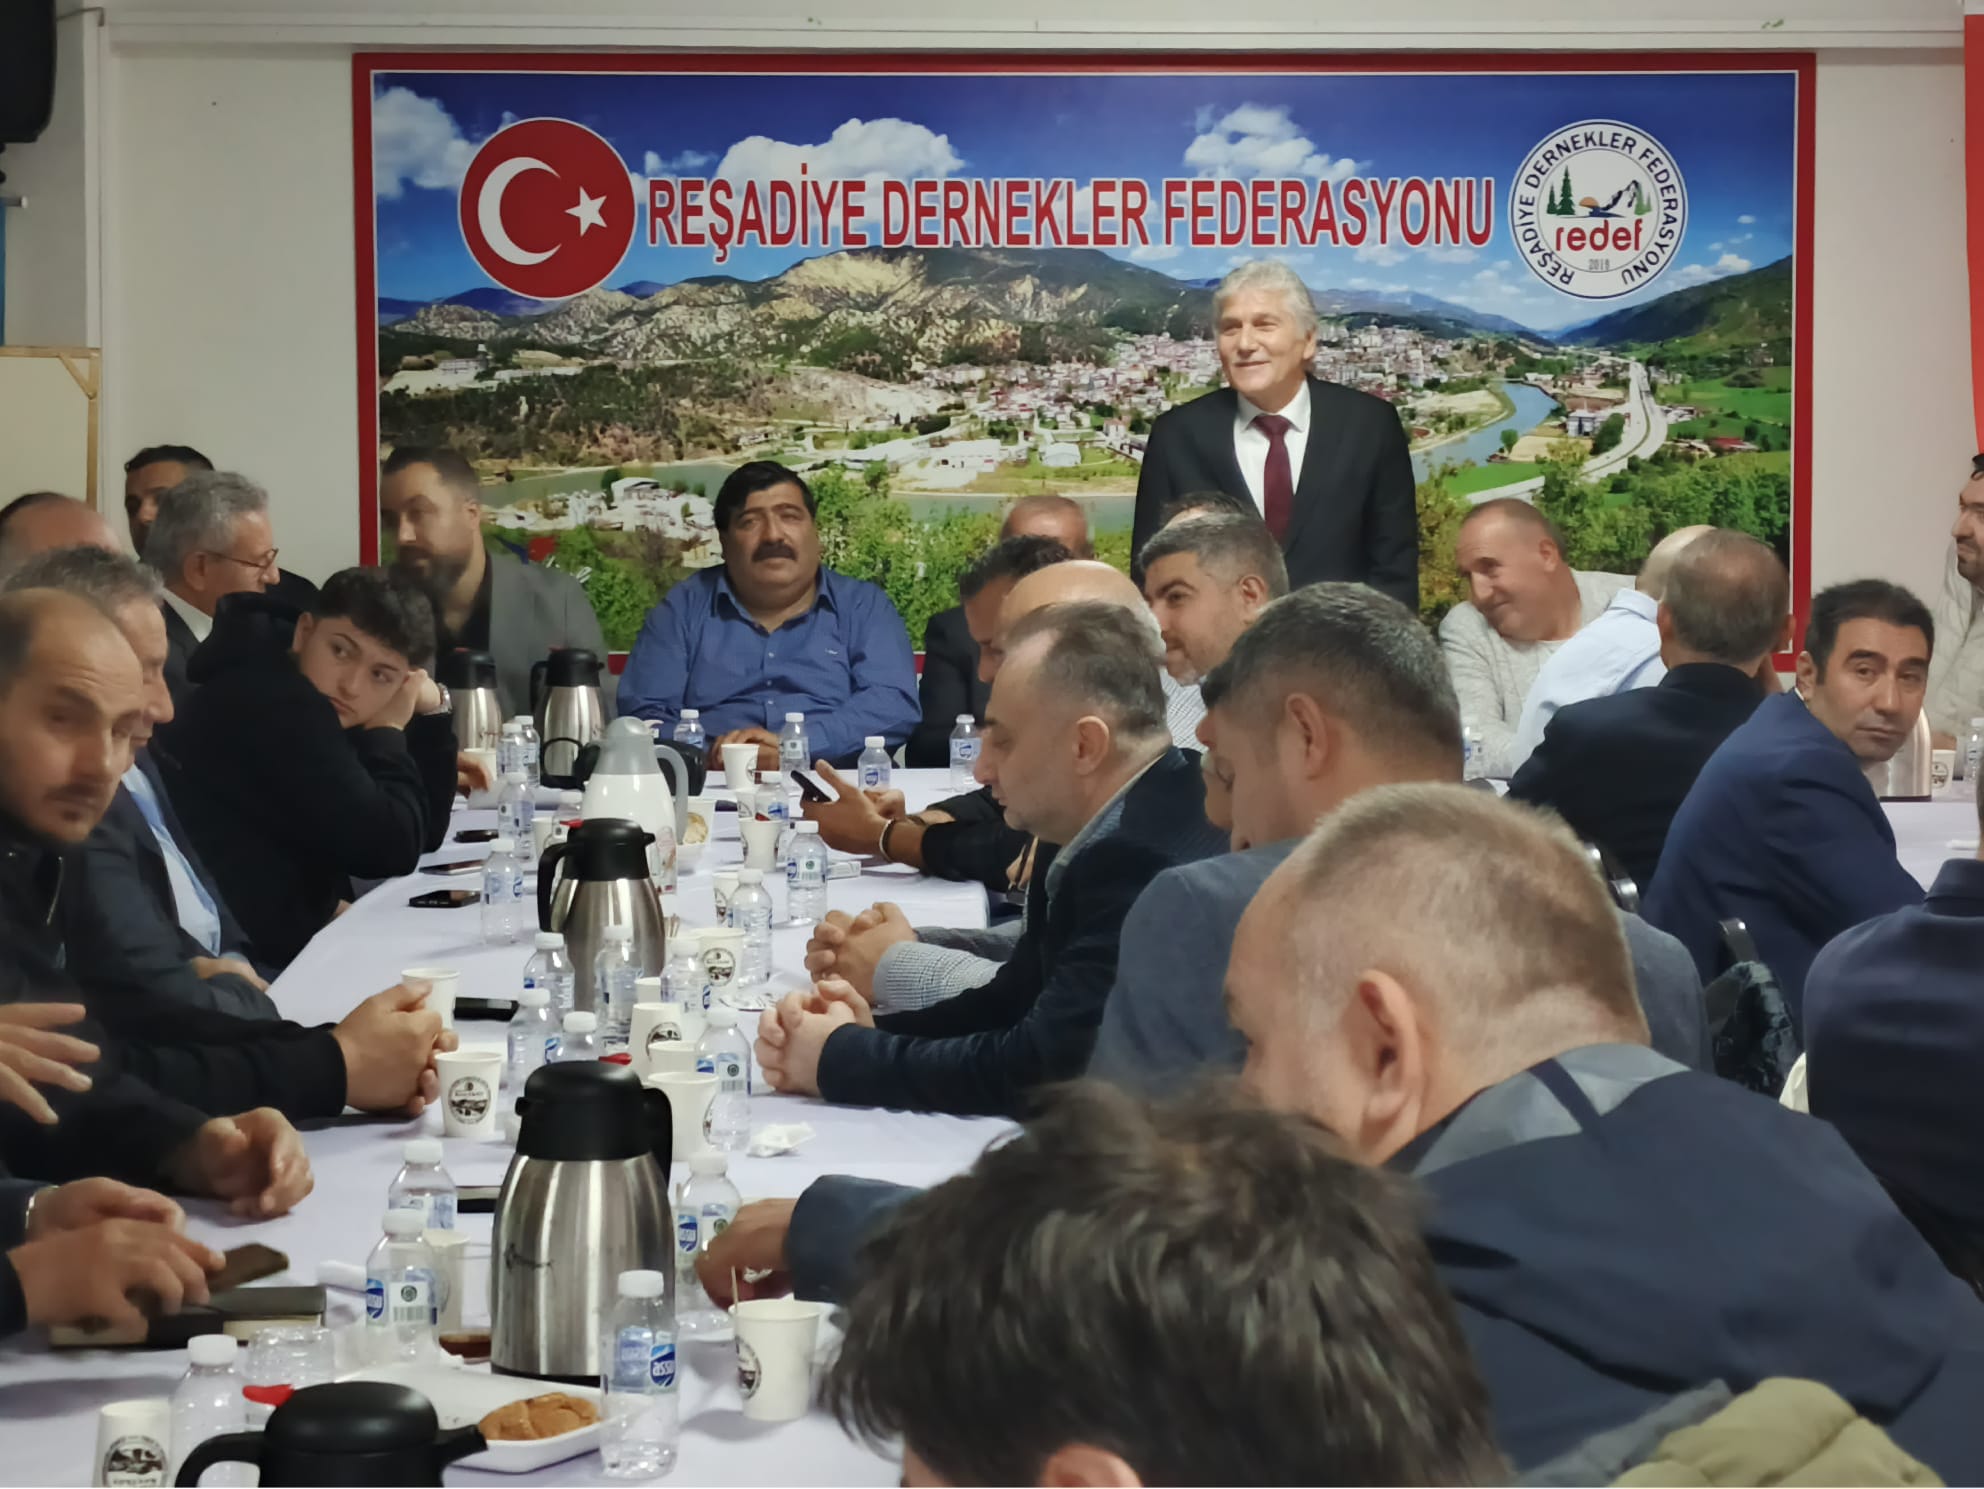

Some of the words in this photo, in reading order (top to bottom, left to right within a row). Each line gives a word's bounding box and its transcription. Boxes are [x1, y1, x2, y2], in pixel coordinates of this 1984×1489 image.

[1524, 130, 1638, 190] DERNEKLER
[648, 162, 867, 263] REŞADİYE
[882, 178, 1150, 246] DERNEKLER
[1164, 177, 1494, 247] FEDERASYONU
[1515, 194, 1576, 286] REŞADİYE
[1555, 217, 1644, 252] redef
[1620, 147, 1680, 286] FEDERASYONU
